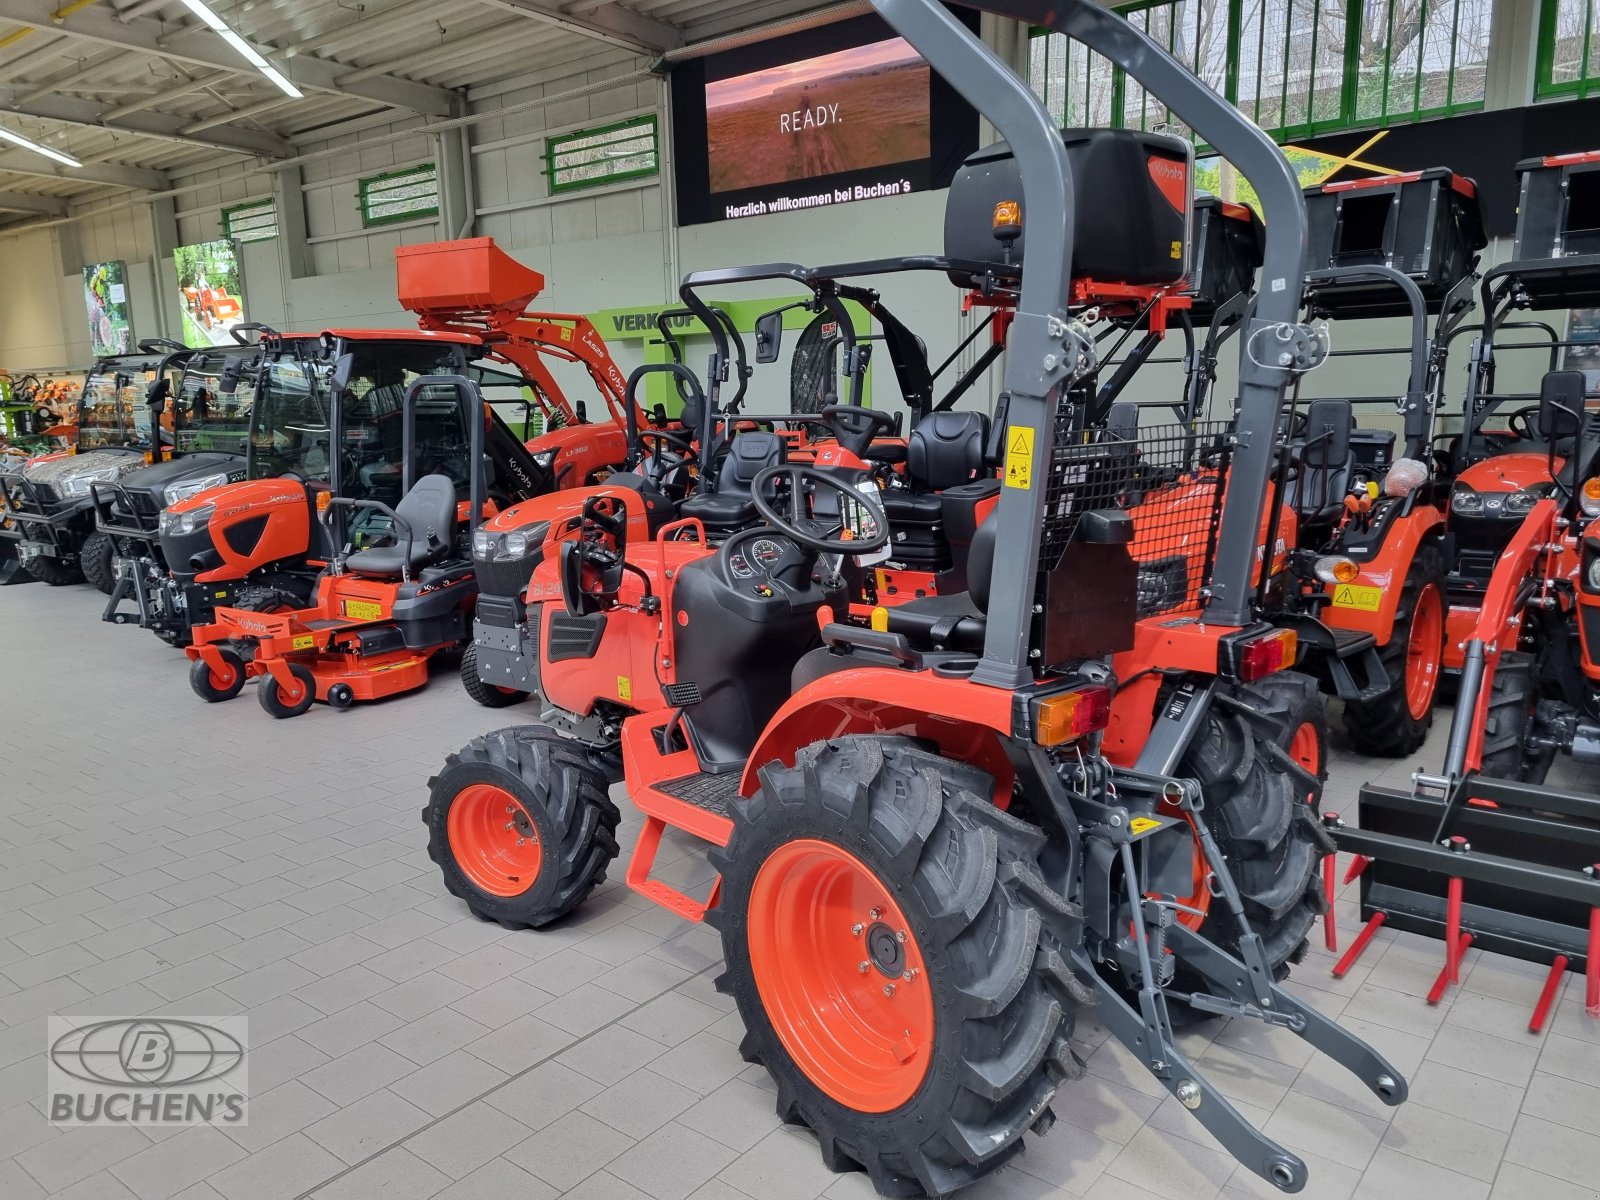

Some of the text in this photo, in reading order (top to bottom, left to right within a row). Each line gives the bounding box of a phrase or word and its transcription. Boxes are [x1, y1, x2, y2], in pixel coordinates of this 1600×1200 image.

[780, 103, 843, 133] READY.
[726, 202, 767, 218] Herzlich
[768, 193, 832, 212] willkommen
[834, 187, 851, 203] bei
[608, 364, 626, 396] Kubo
[508, 457, 532, 488] Kubota
[237, 617, 267, 633] Kubota
